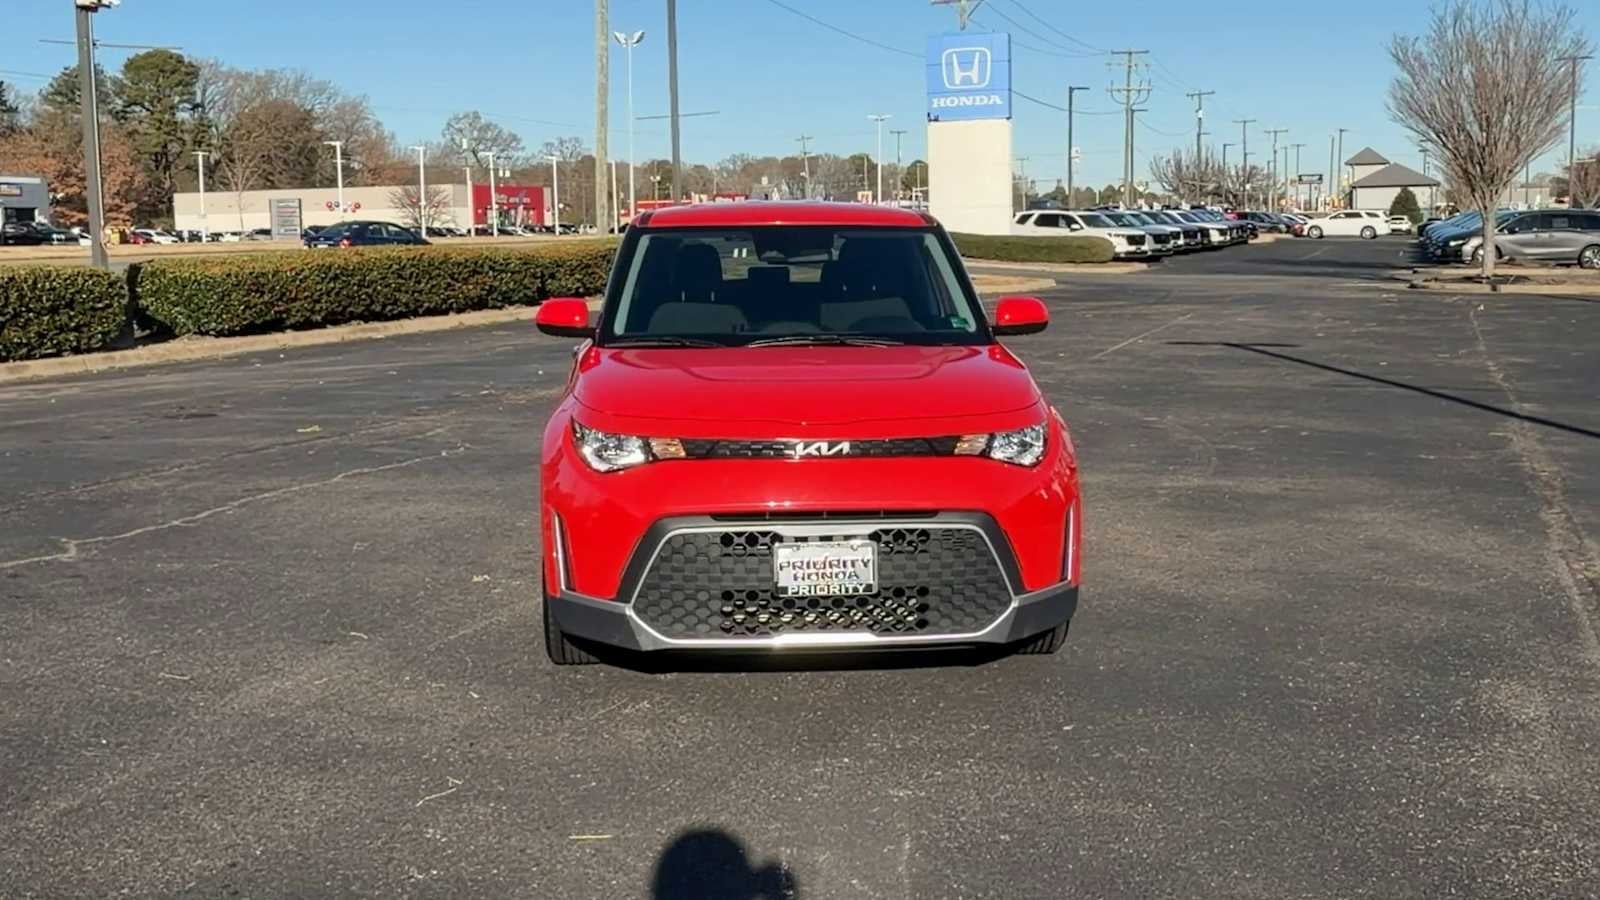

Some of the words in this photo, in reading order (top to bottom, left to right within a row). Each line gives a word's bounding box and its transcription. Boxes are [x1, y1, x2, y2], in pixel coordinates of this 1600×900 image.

[931, 95, 1003, 108] HONDA
[779, 557, 871, 571] PRIORITY
[793, 570, 860, 581] HONDA
[787, 583, 866, 596] PRIORITY
